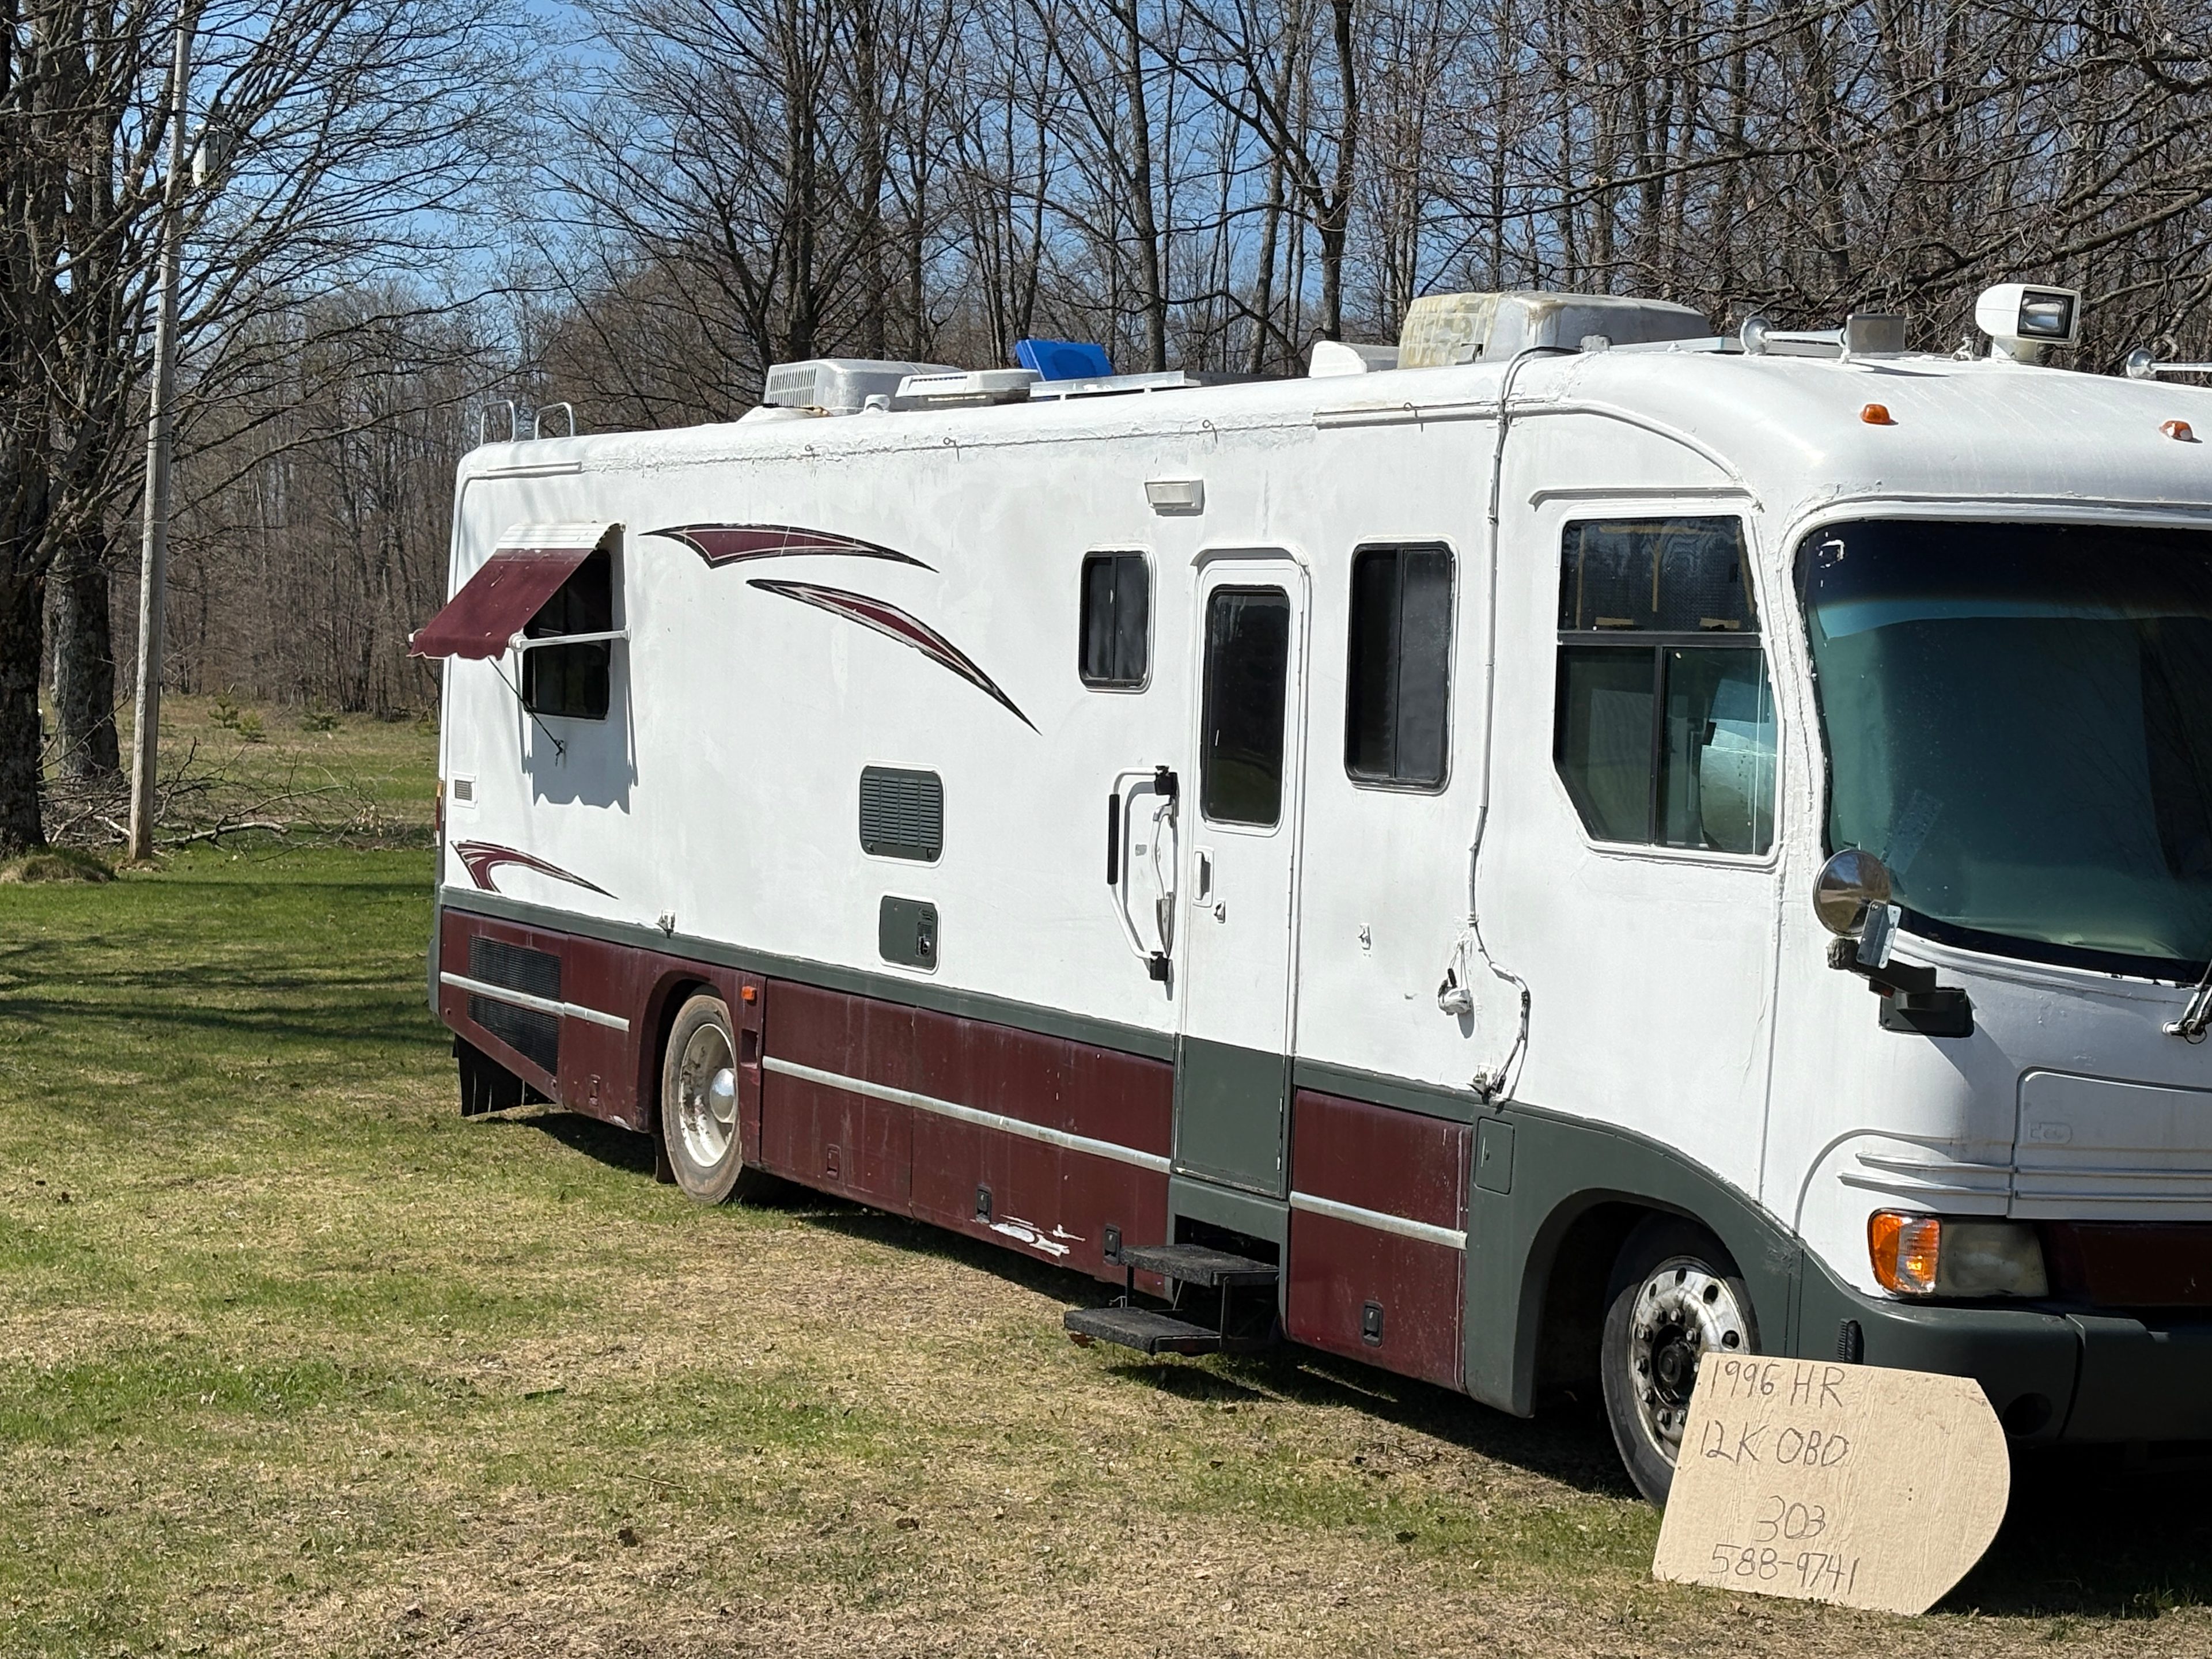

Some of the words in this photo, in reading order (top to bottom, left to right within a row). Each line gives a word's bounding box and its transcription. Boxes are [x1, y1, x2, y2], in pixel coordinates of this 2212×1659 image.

[1710, 1360, 1781, 1398] 1996
[1790, 1362, 1845, 1409] HR
[1755, 1495, 1826, 1542] 303
[1708, 1544, 1859, 1595] 588-9741
